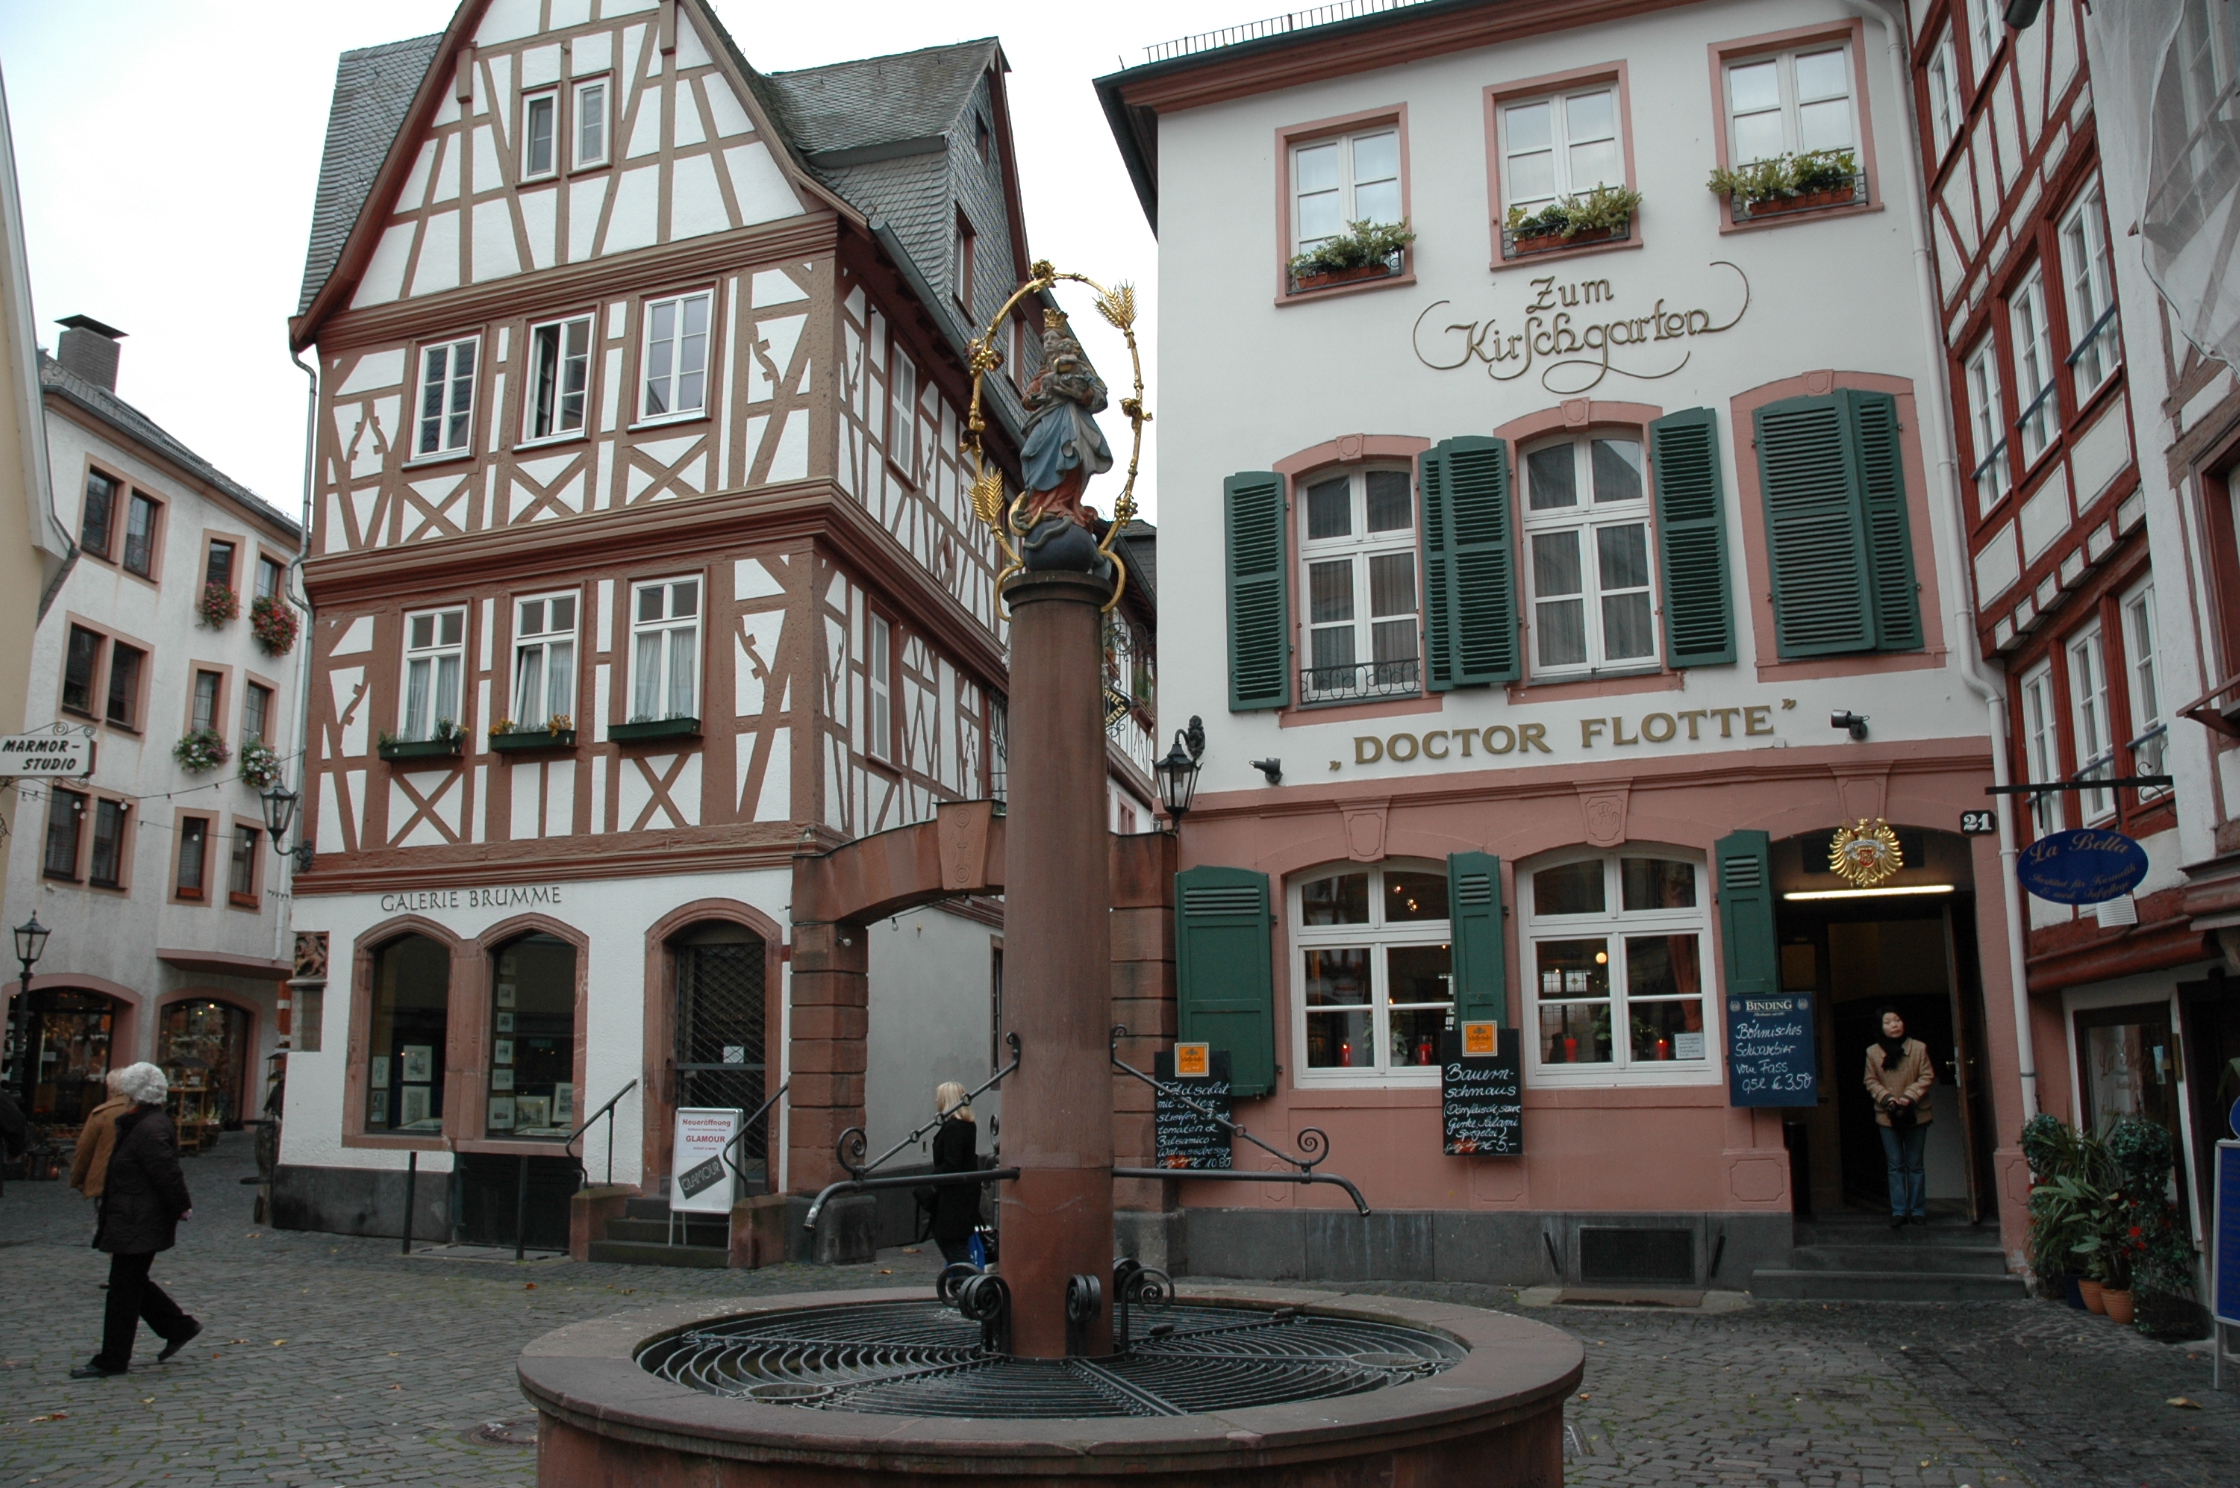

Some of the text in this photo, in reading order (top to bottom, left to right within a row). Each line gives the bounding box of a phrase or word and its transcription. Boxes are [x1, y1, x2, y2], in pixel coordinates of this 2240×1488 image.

[1525, 275, 1614, 314] Zum
[22, 758, 77, 770] STUDIO
[1963, 813, 1992, 831] 21
[2029, 832, 2129, 865] La Bella
[2028, 863, 2136, 890] Institut für Kosmetik
[381, 887, 562, 912] GALERIE BRUMME
[1746, 1000, 1792, 1011] BINDING
[1735, 1019, 1802, 1039] Böhmisches
[1445, 1063, 1514, 1082] Bauern-
[1736, 1059, 1788, 1075] vom Fass
[1771, 1075, 1783, 1090] €
[1445, 1085, 1516, 1098] schmaus
[1157, 1100, 1175, 1108] mit
[682, 1118, 731, 1127] Neueröffnung
[1157, 1124, 1203, 1135] tomaten
[686, 1135, 726, 1143] GLAMOUR
[681, 1161, 721, 1191] GLAMOUR
